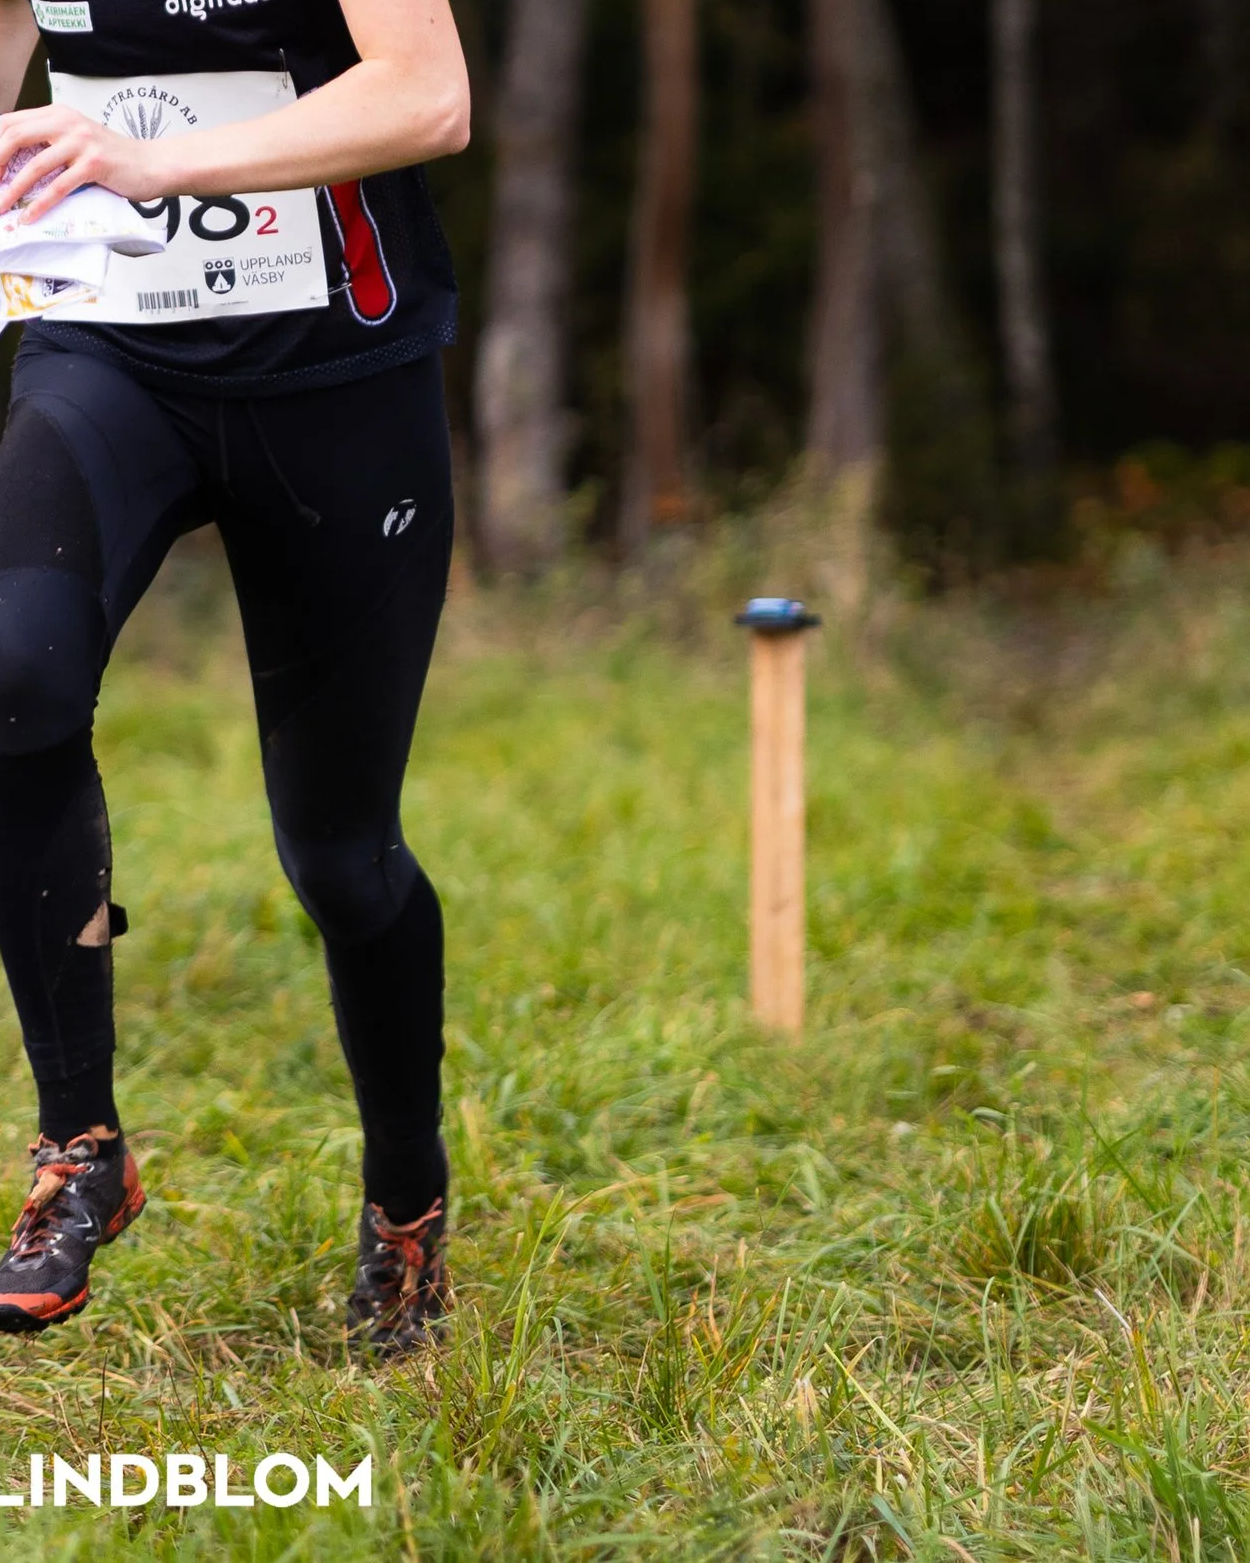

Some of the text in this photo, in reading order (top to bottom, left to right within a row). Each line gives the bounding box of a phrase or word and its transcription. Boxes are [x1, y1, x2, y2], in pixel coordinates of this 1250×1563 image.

[137, 85, 179, 107] GÅRD
[180, 106, 198, 126] AB
[255, 206, 279, 235] 2
[240, 250, 312, 271] UPPLANDS
[243, 271, 285, 286] VÄSBY
